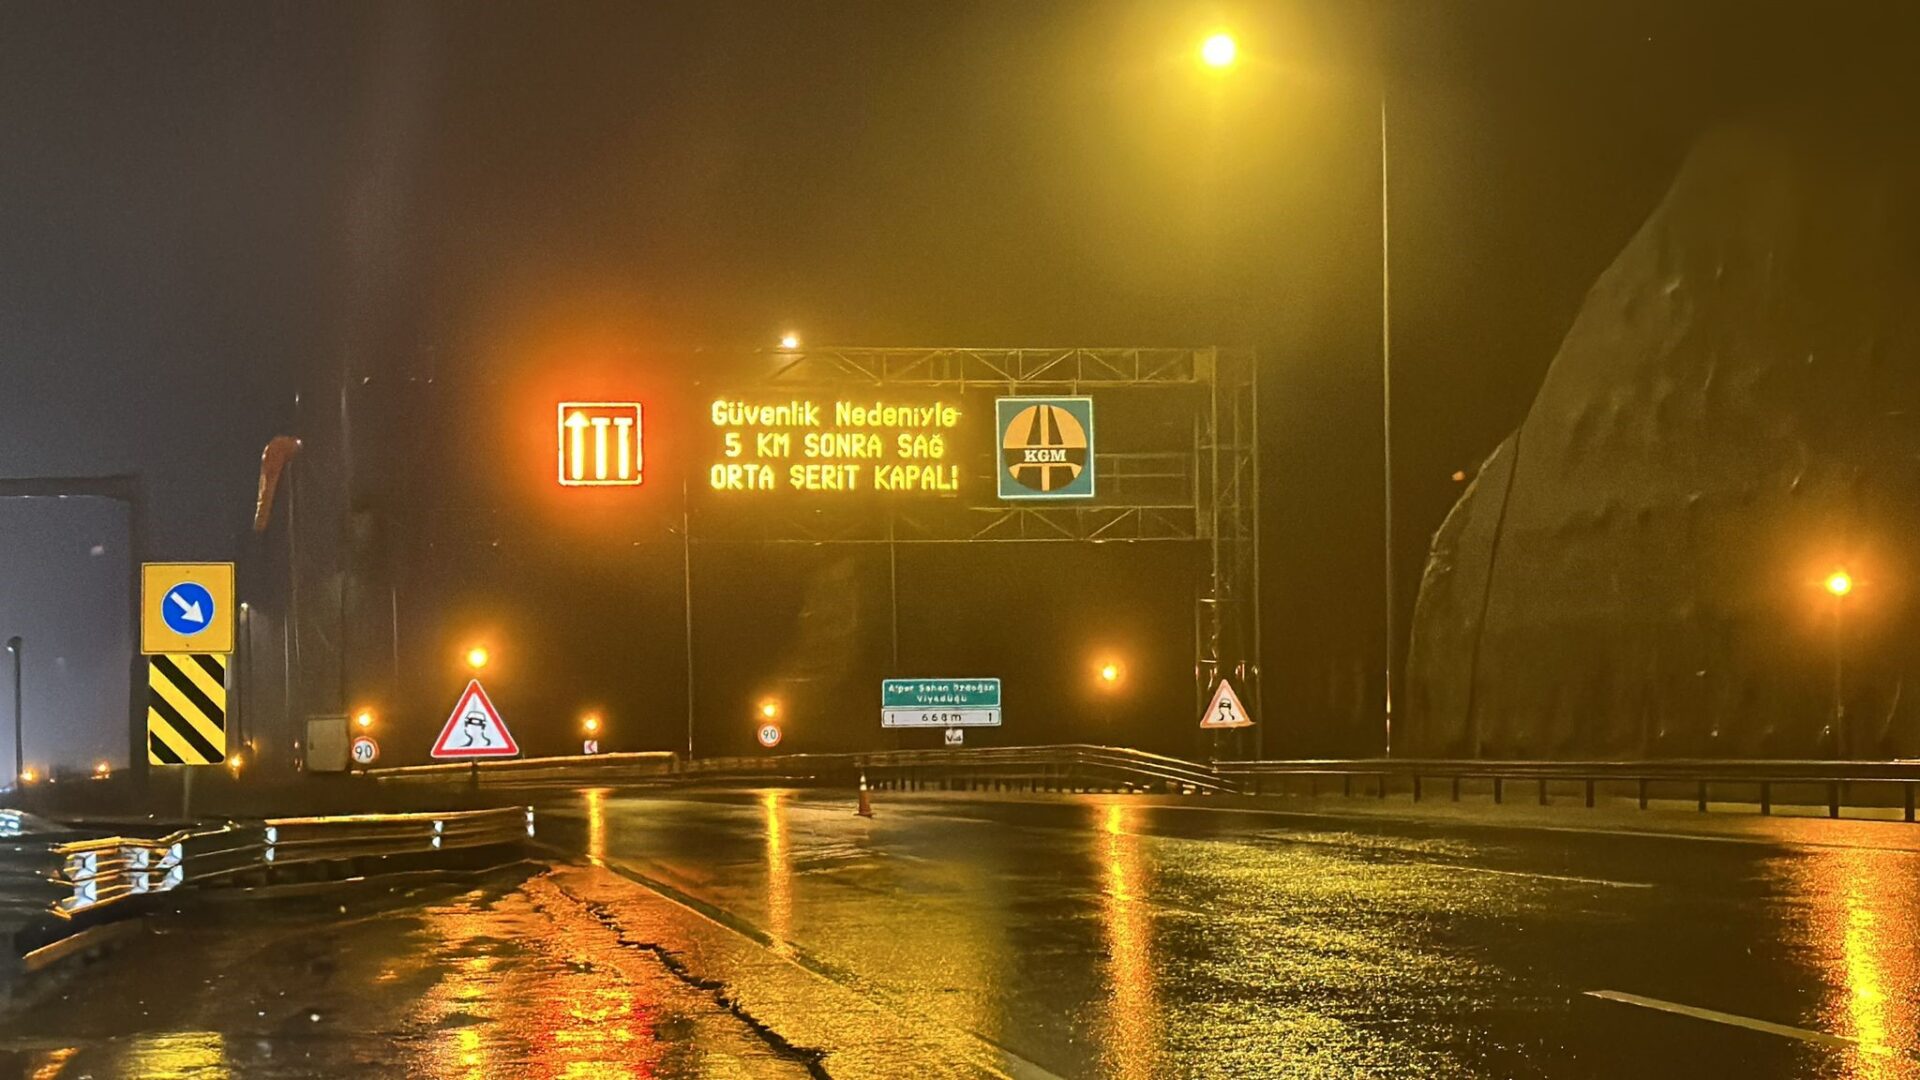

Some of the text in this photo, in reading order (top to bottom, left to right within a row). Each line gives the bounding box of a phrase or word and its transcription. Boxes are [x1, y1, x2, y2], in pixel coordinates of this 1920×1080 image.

[712, 399, 957, 427] Güvenlik Nedeniyle
[725, 432, 944, 459] 5 KM SONRA SAĞ
[1024, 449, 1067, 462] KGM
[710, 463, 775, 490] ORTA
[789, 464, 860, 490] ŞERİT
[763, 729, 777, 740] 90
[355, 744, 373, 760] 90
